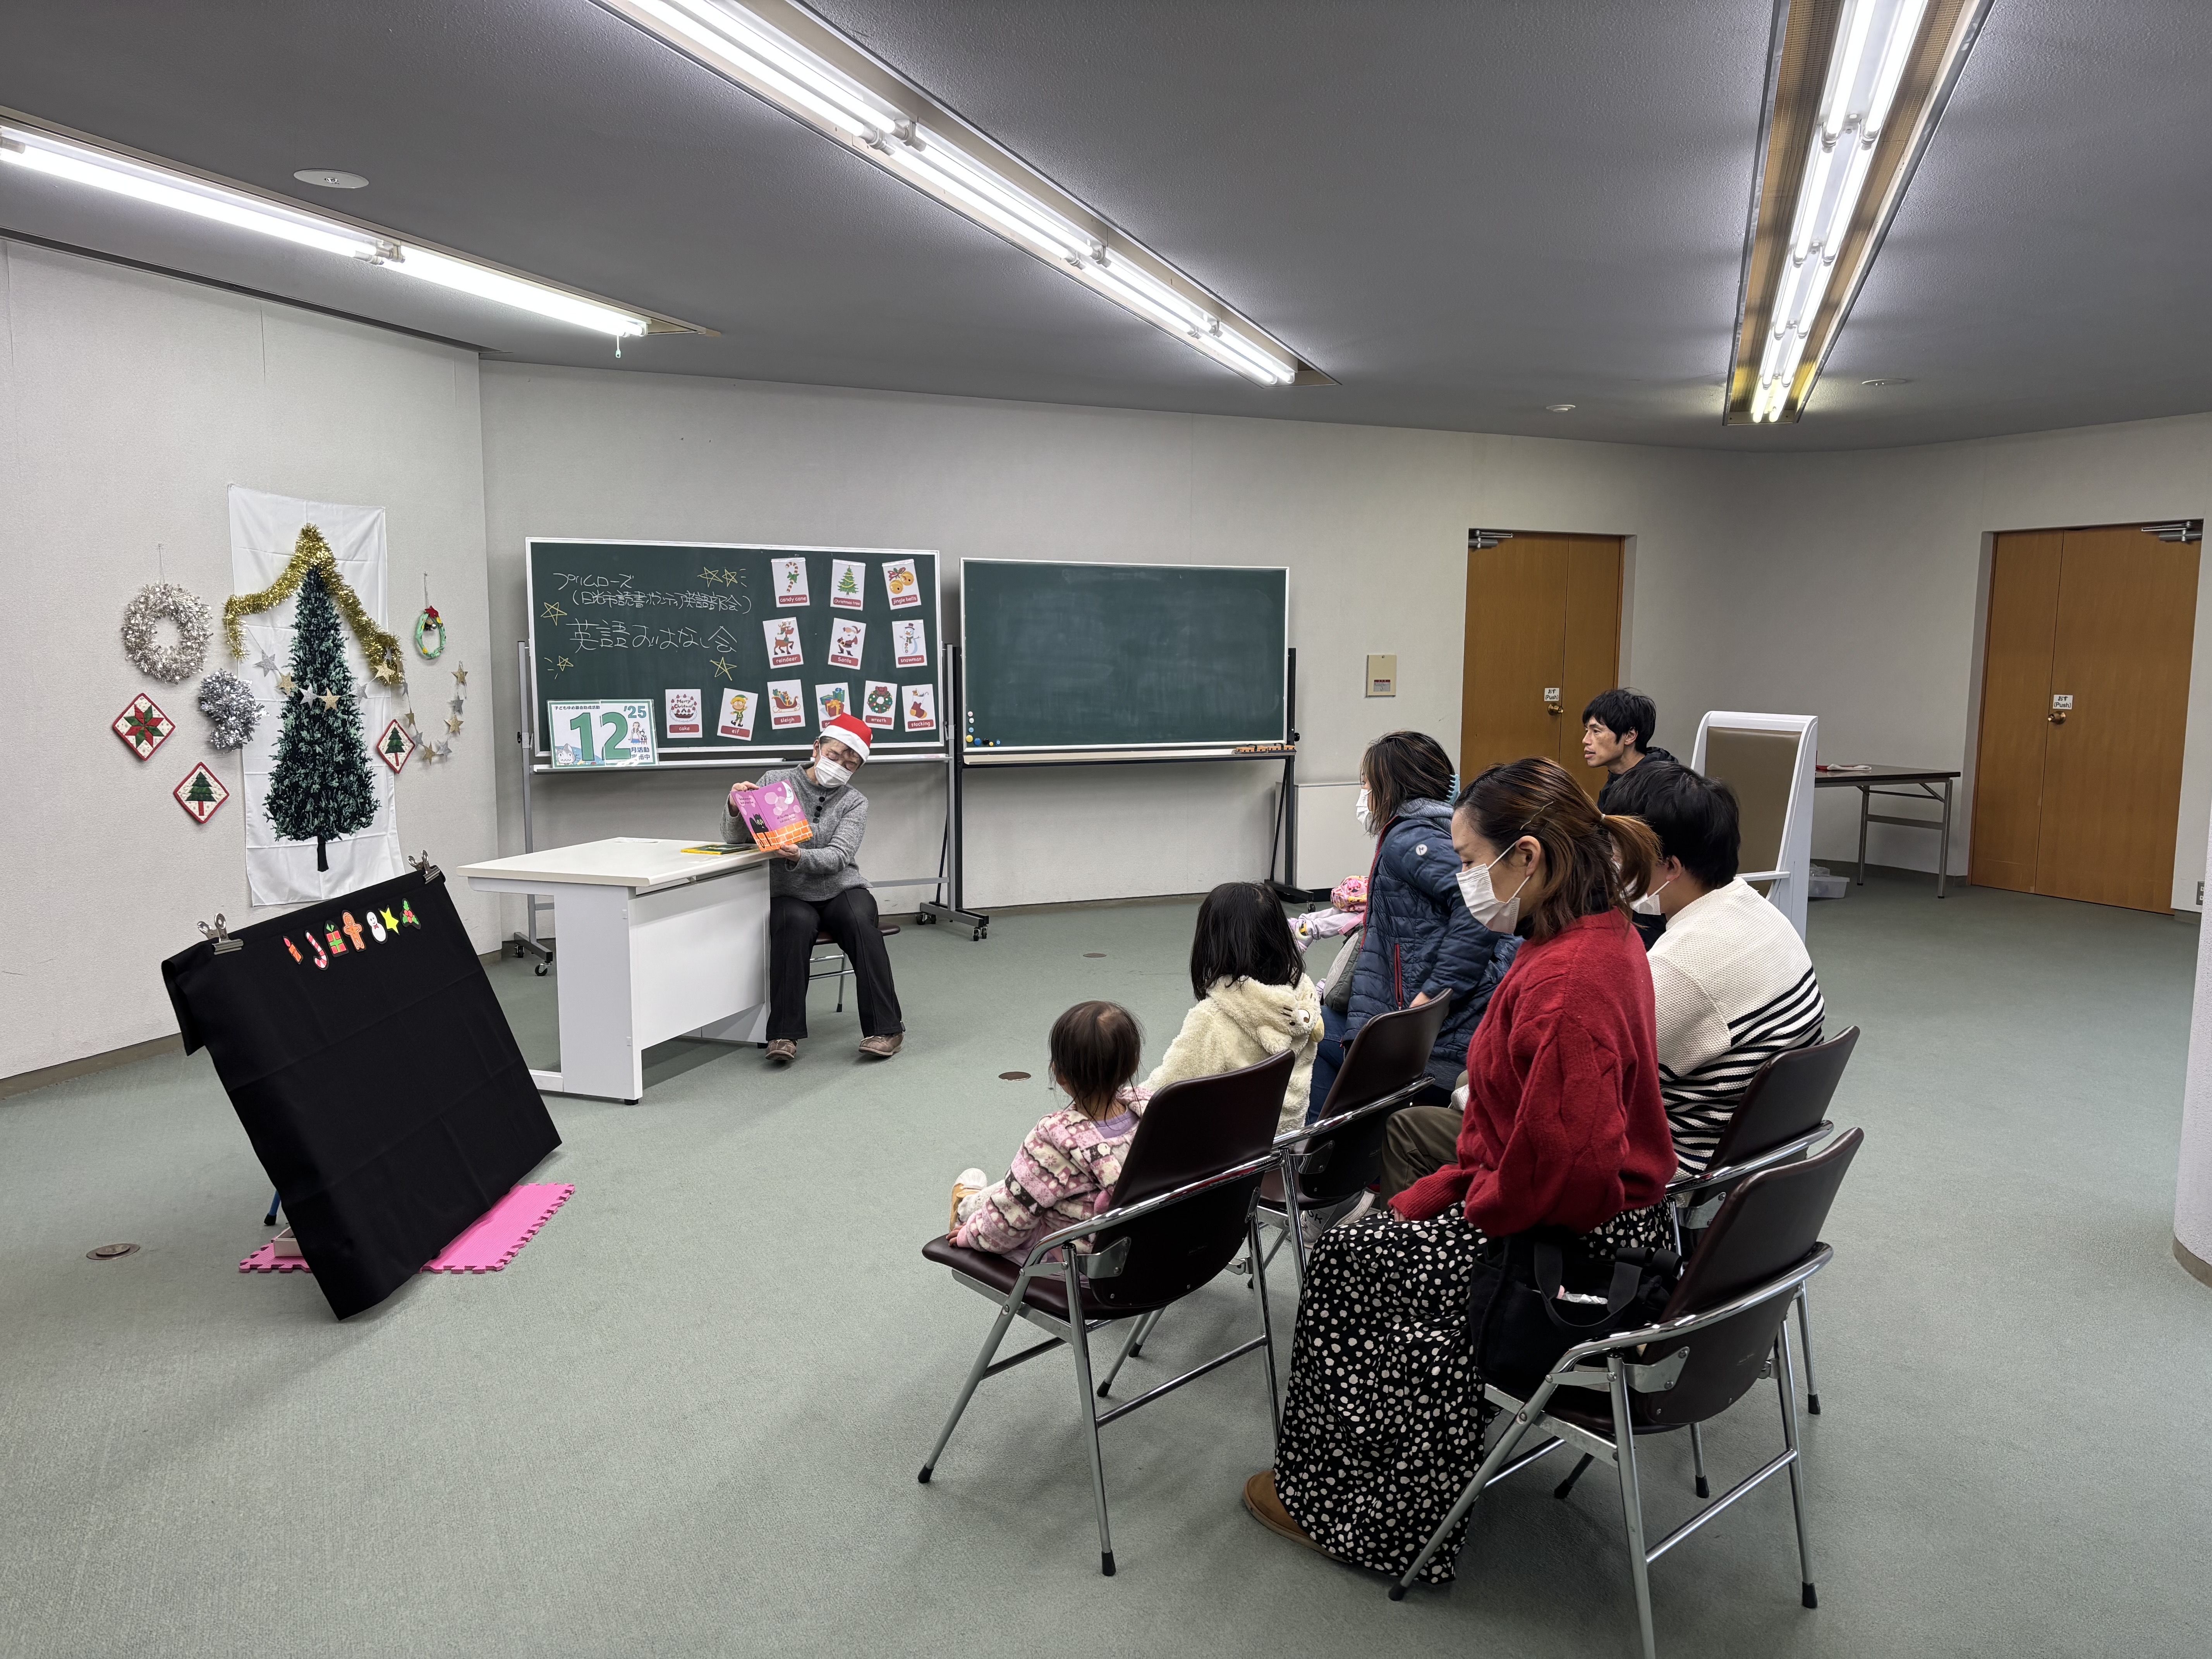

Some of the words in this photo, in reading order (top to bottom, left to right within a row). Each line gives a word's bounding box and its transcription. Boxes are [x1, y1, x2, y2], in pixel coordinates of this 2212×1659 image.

[553, 574, 634, 590] プリムローズ
[566, 618, 737, 653] 英語おはなし会
[623, 706, 647, 718] '25
[570, 712, 631, 761] 12
